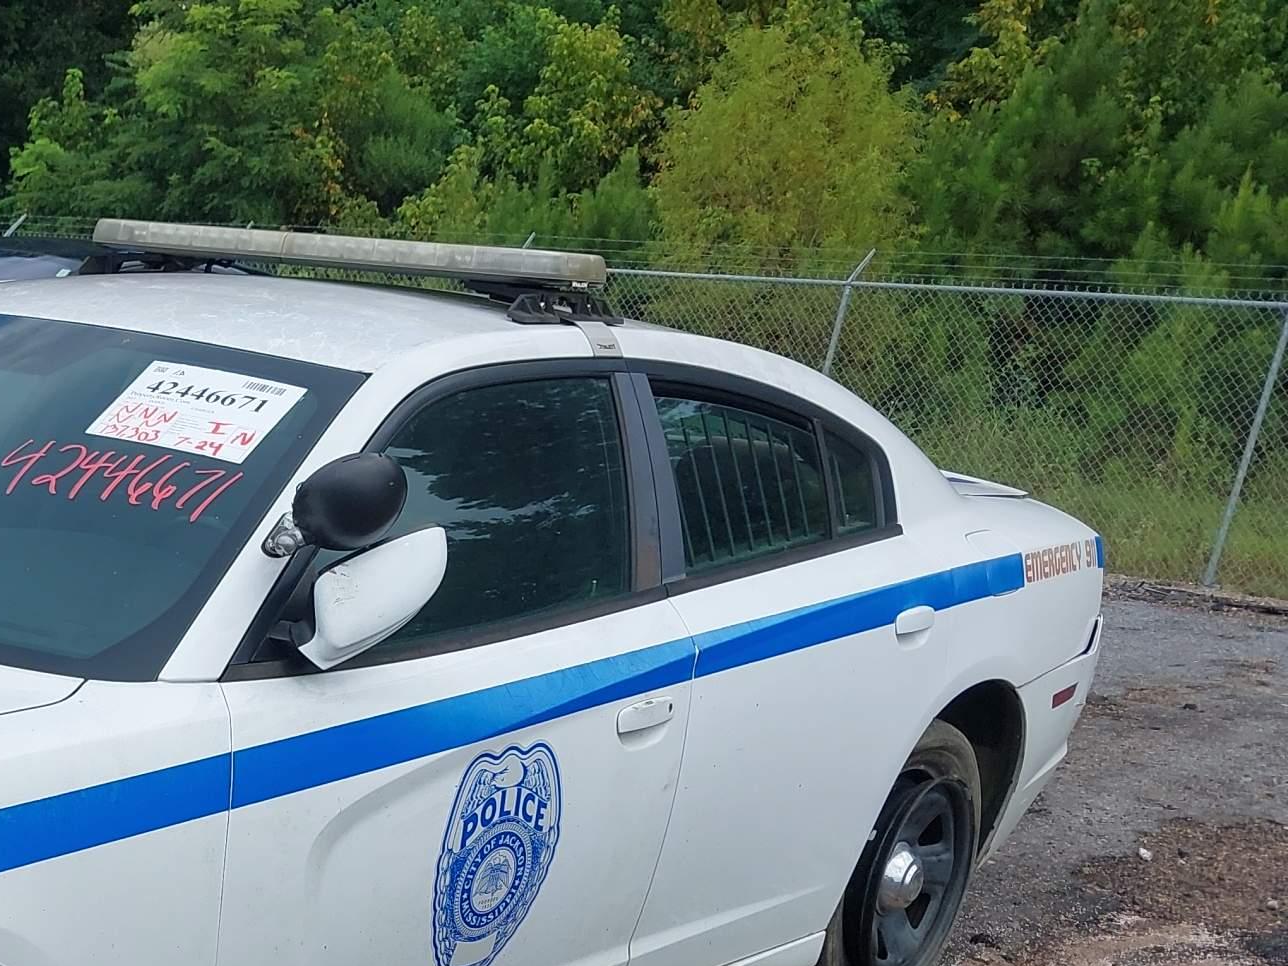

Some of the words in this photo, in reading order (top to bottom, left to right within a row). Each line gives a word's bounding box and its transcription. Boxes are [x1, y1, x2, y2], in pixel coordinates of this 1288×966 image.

[147, 380, 269, 413] 42446671
[1, 439, 244, 523] 42446671
[1024, 541, 1081, 583] EMERGENCY
[460, 787, 548, 850] POLICE
[464, 853, 482, 889] CITY
[483, 839, 497, 855] OF
[498, 834, 525, 877] JACKSON
[461, 887, 517, 926] MISSISSIPPI
